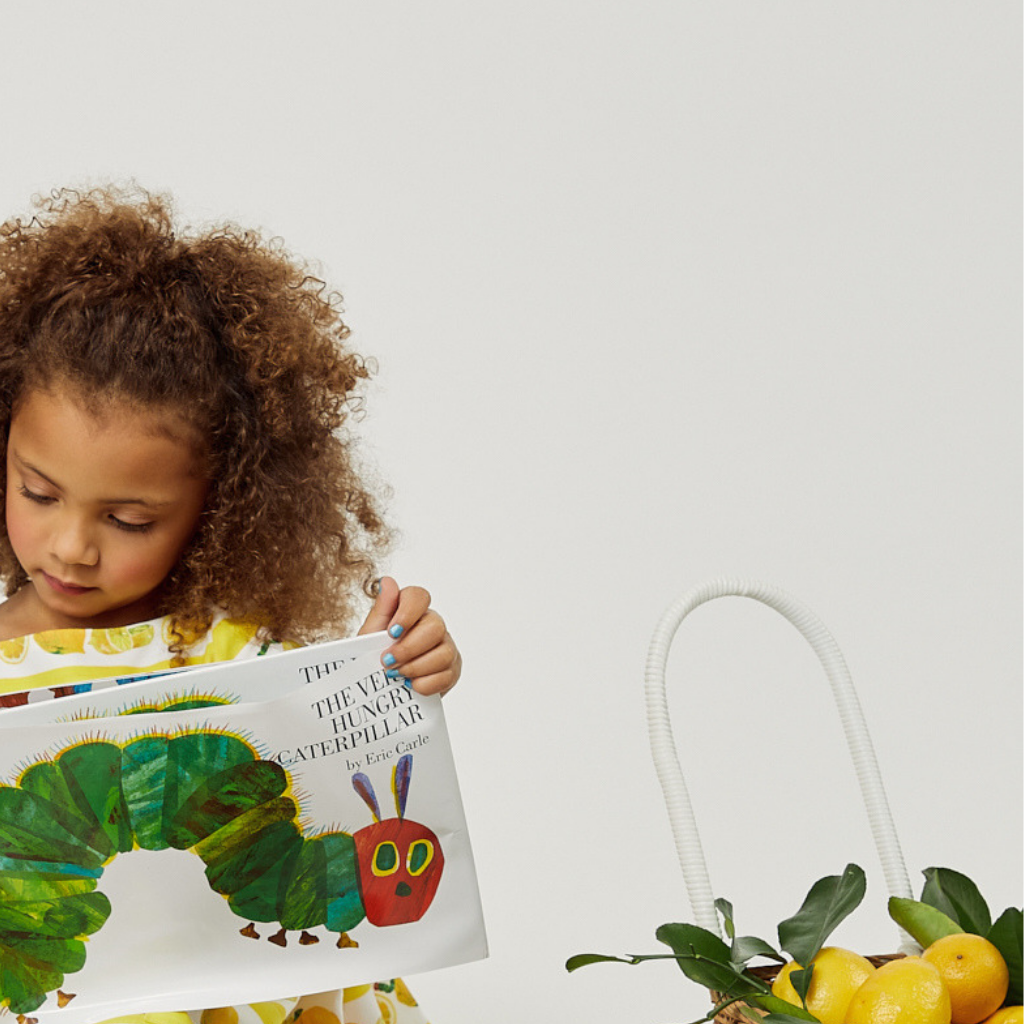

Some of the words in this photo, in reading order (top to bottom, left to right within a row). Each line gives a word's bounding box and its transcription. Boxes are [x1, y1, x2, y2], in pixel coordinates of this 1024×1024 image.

[311, 686, 356, 719] THE
[331, 684, 414, 735] HUNGRY
[277, 703, 425, 764] CATERPILLAR
[346, 759, 363, 773] by
[365, 748, 393, 766] Eric
[395, 733, 430, 755] Carle
